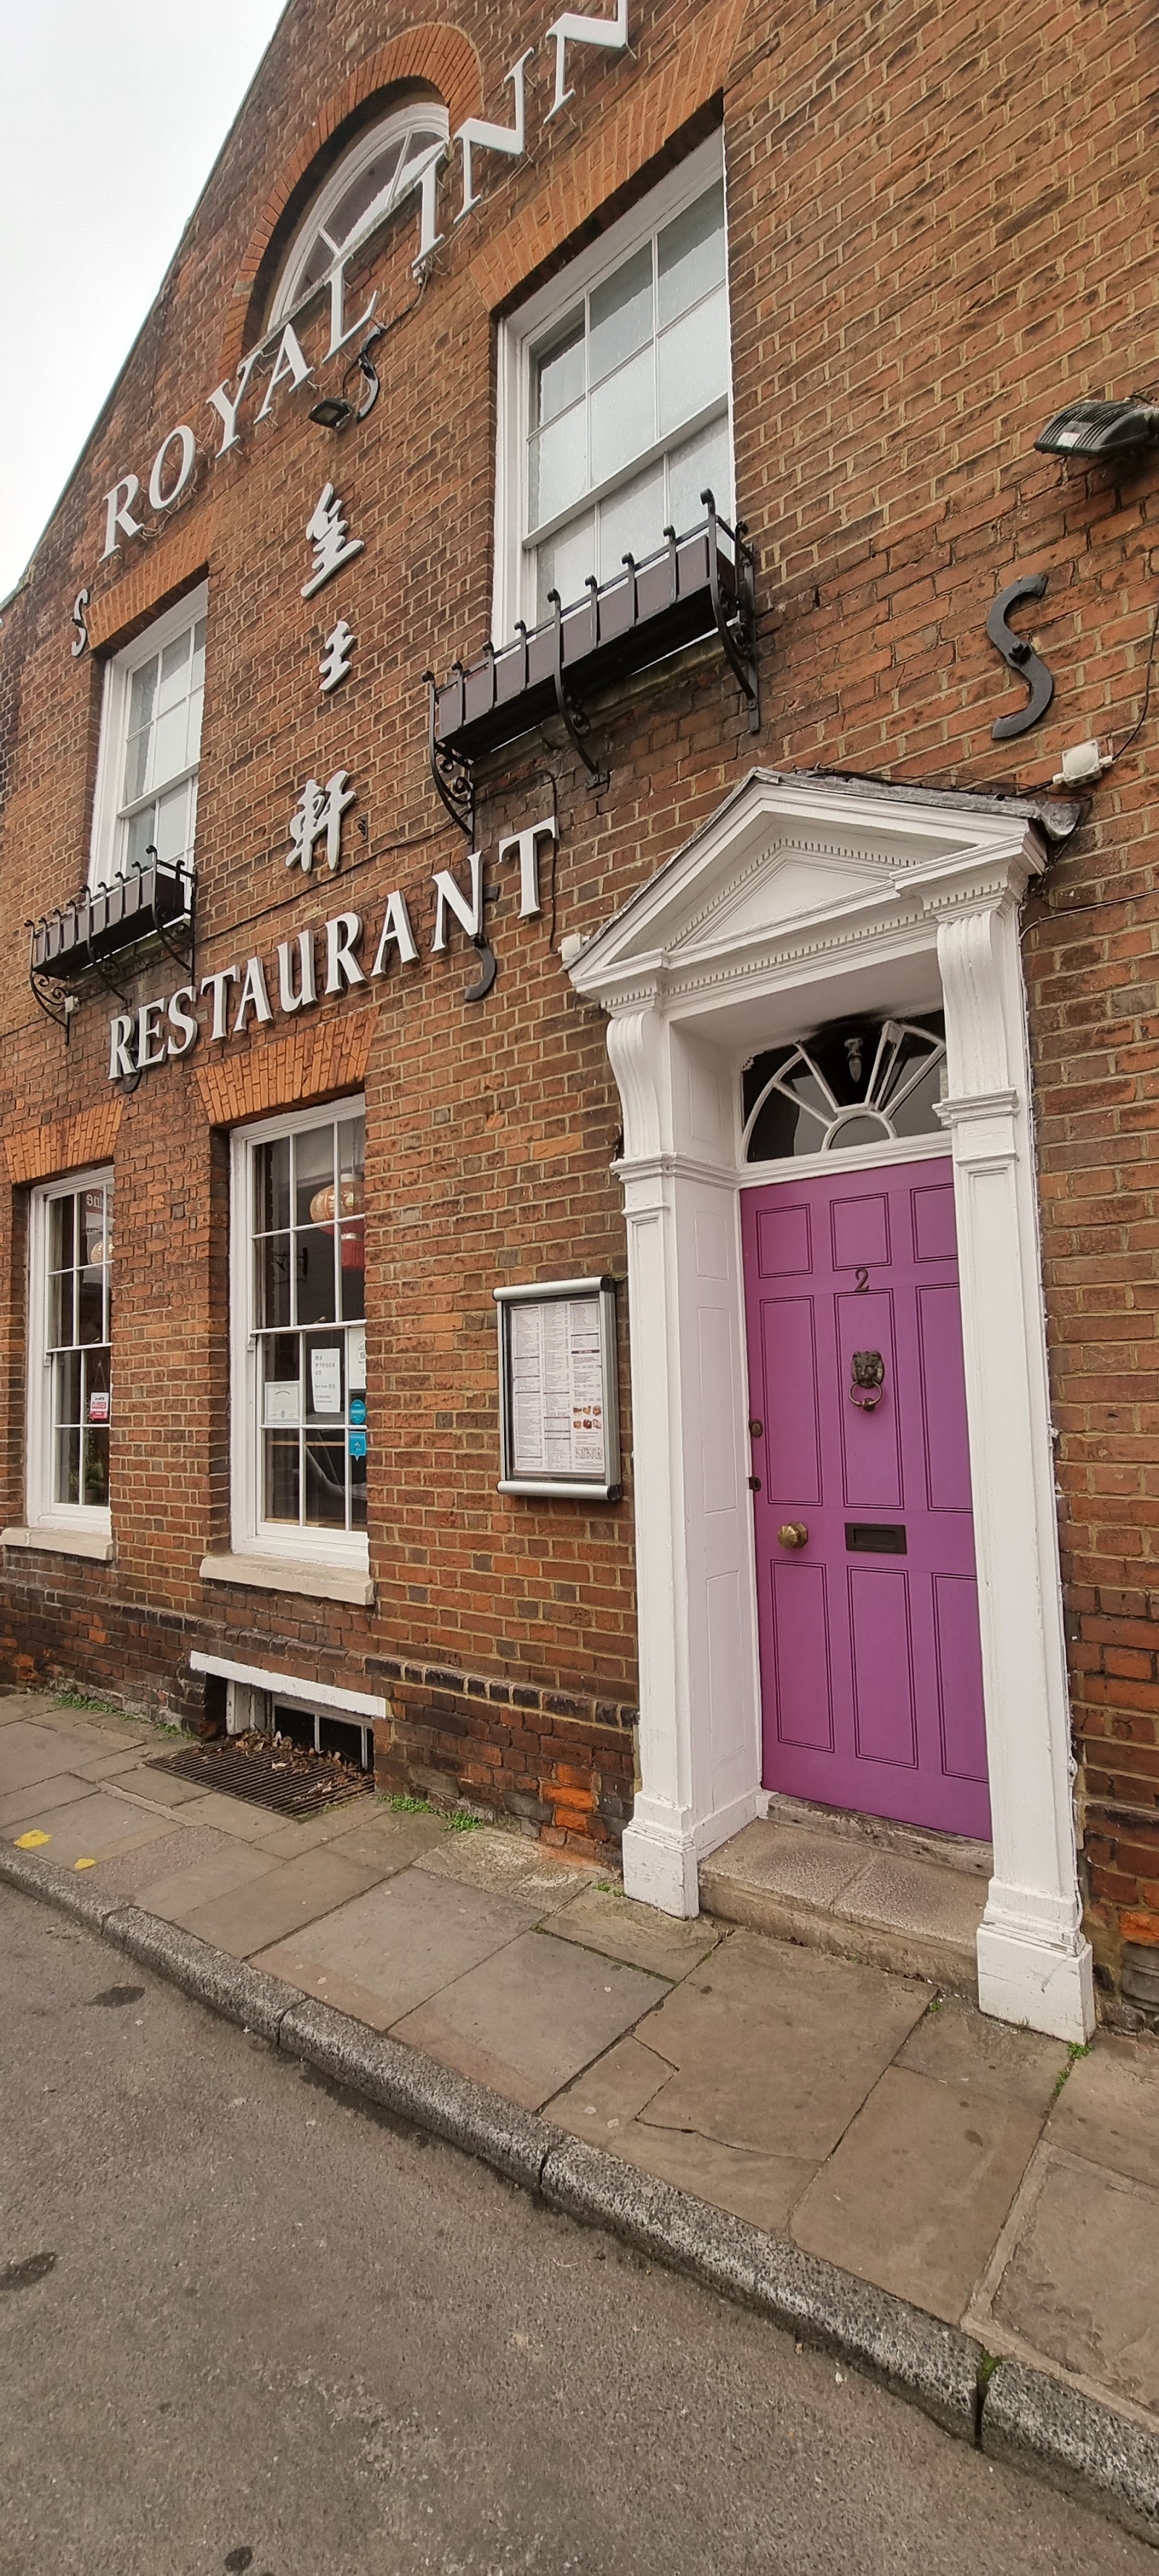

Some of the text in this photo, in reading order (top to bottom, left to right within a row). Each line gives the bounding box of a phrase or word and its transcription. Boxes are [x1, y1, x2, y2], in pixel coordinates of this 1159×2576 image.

[99, 0, 629, 564] ROYAL INN
[107, 816, 559, 1081] RESTAURANT
[855, 1268, 869, 1292] 2
